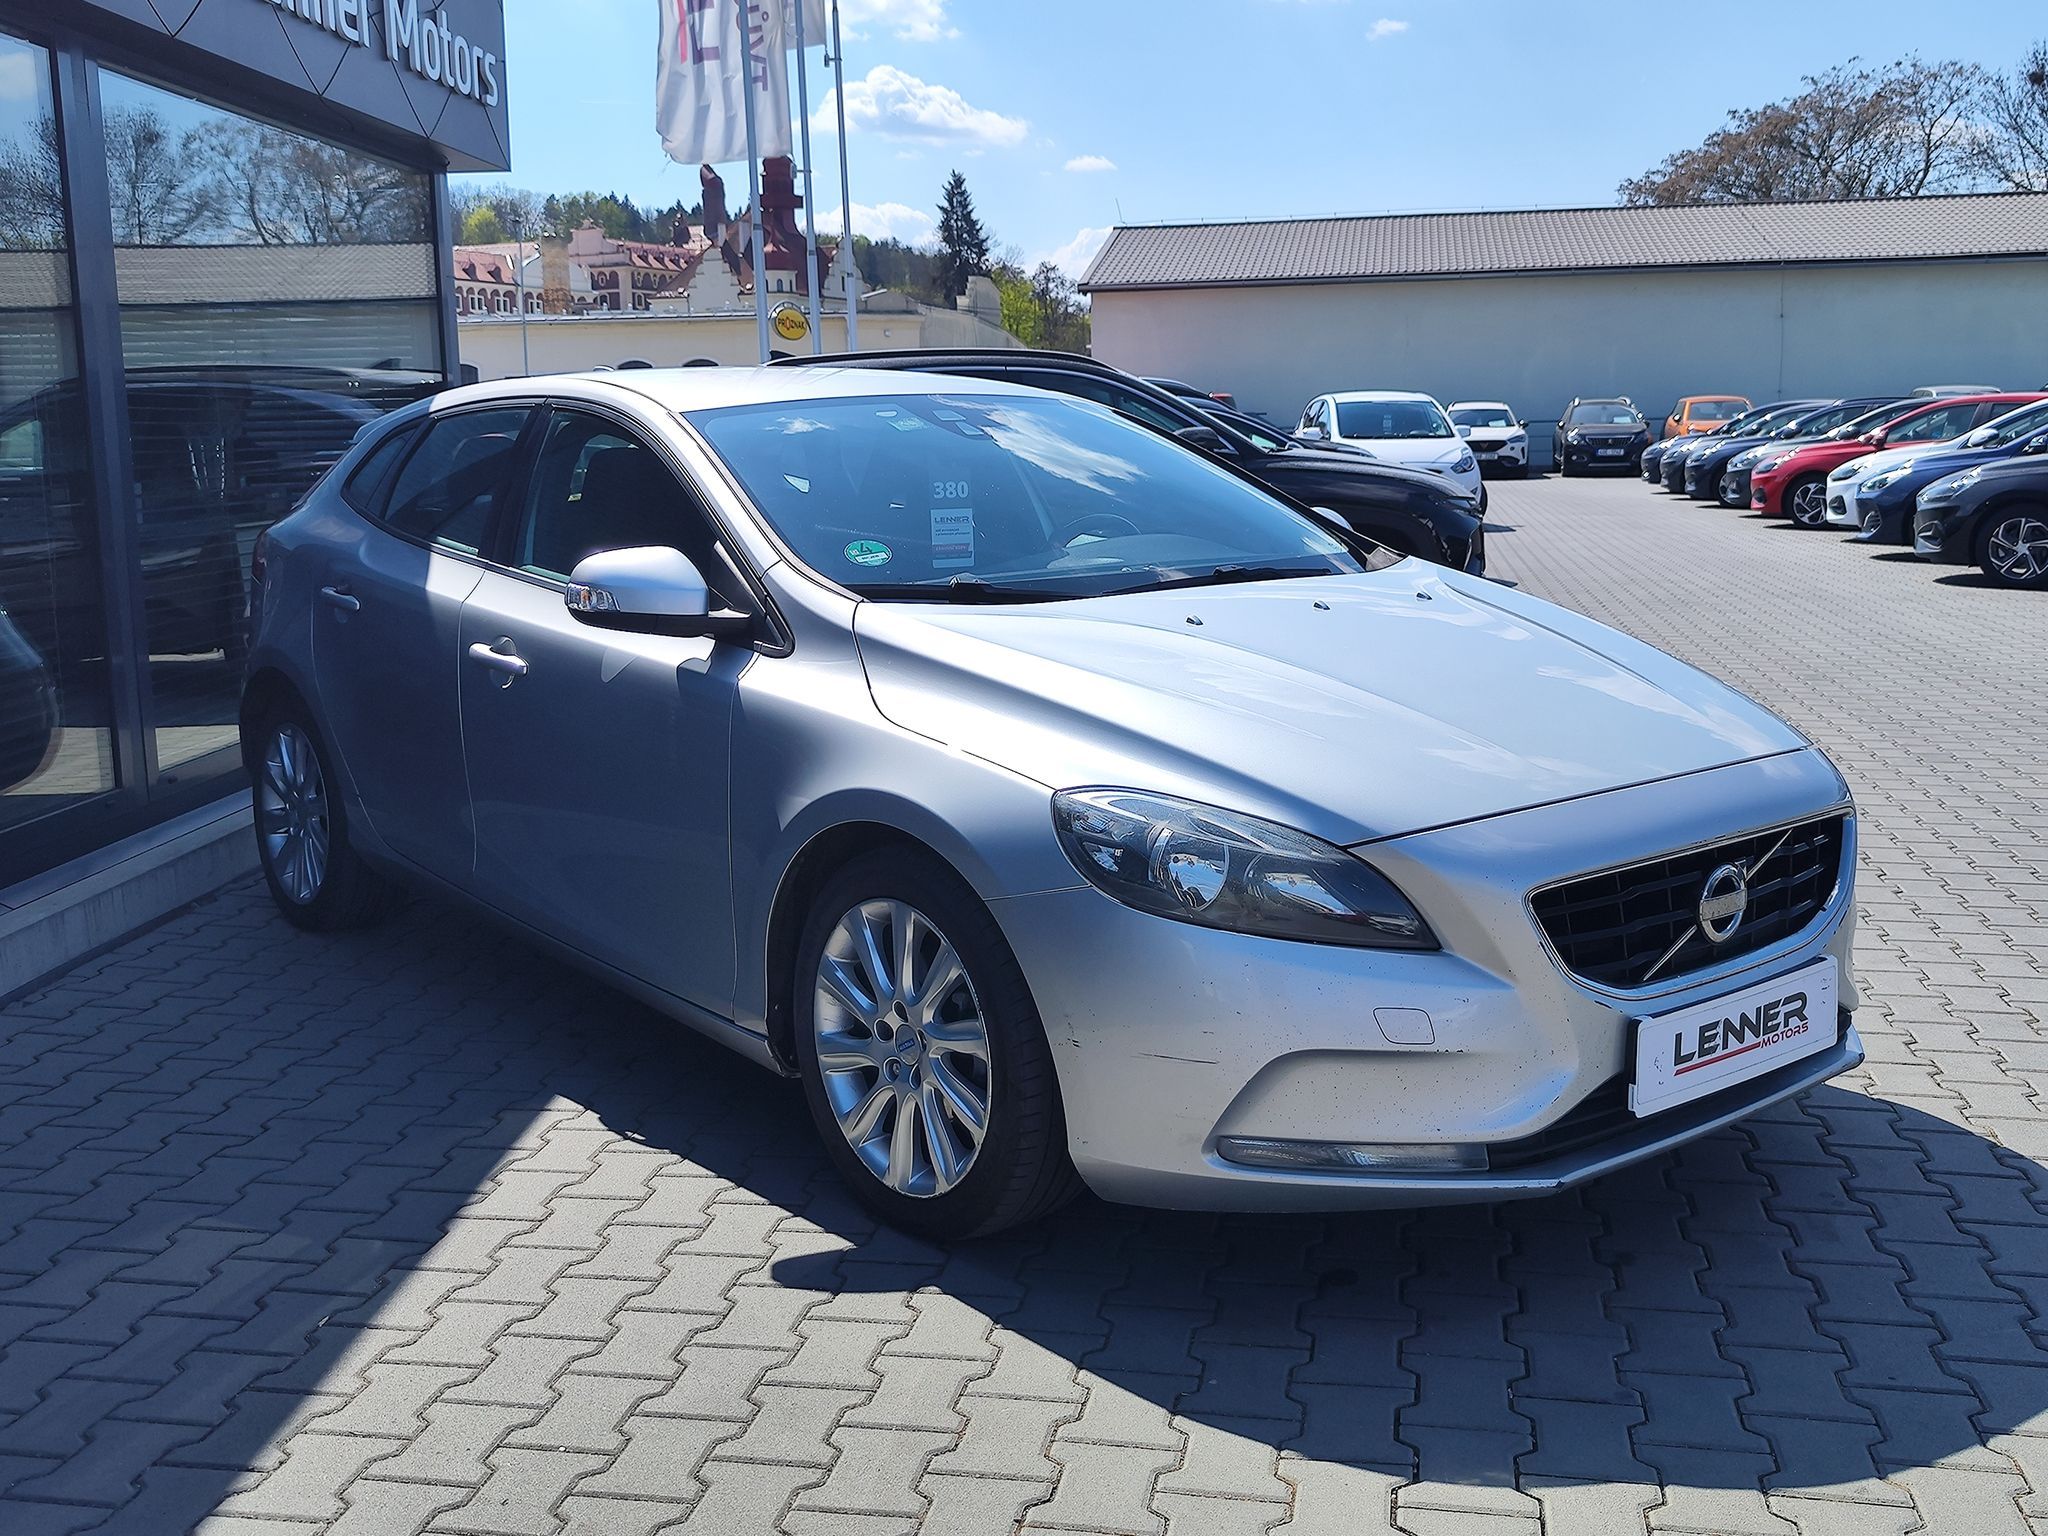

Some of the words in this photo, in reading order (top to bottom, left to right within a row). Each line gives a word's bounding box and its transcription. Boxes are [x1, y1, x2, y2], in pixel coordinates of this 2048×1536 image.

[385, 0, 498, 107] Motors
[933, 480, 969, 499] 380
[1673, 991, 1808, 1066] LENNER
[1760, 1022, 1809, 1049] MOTORS
